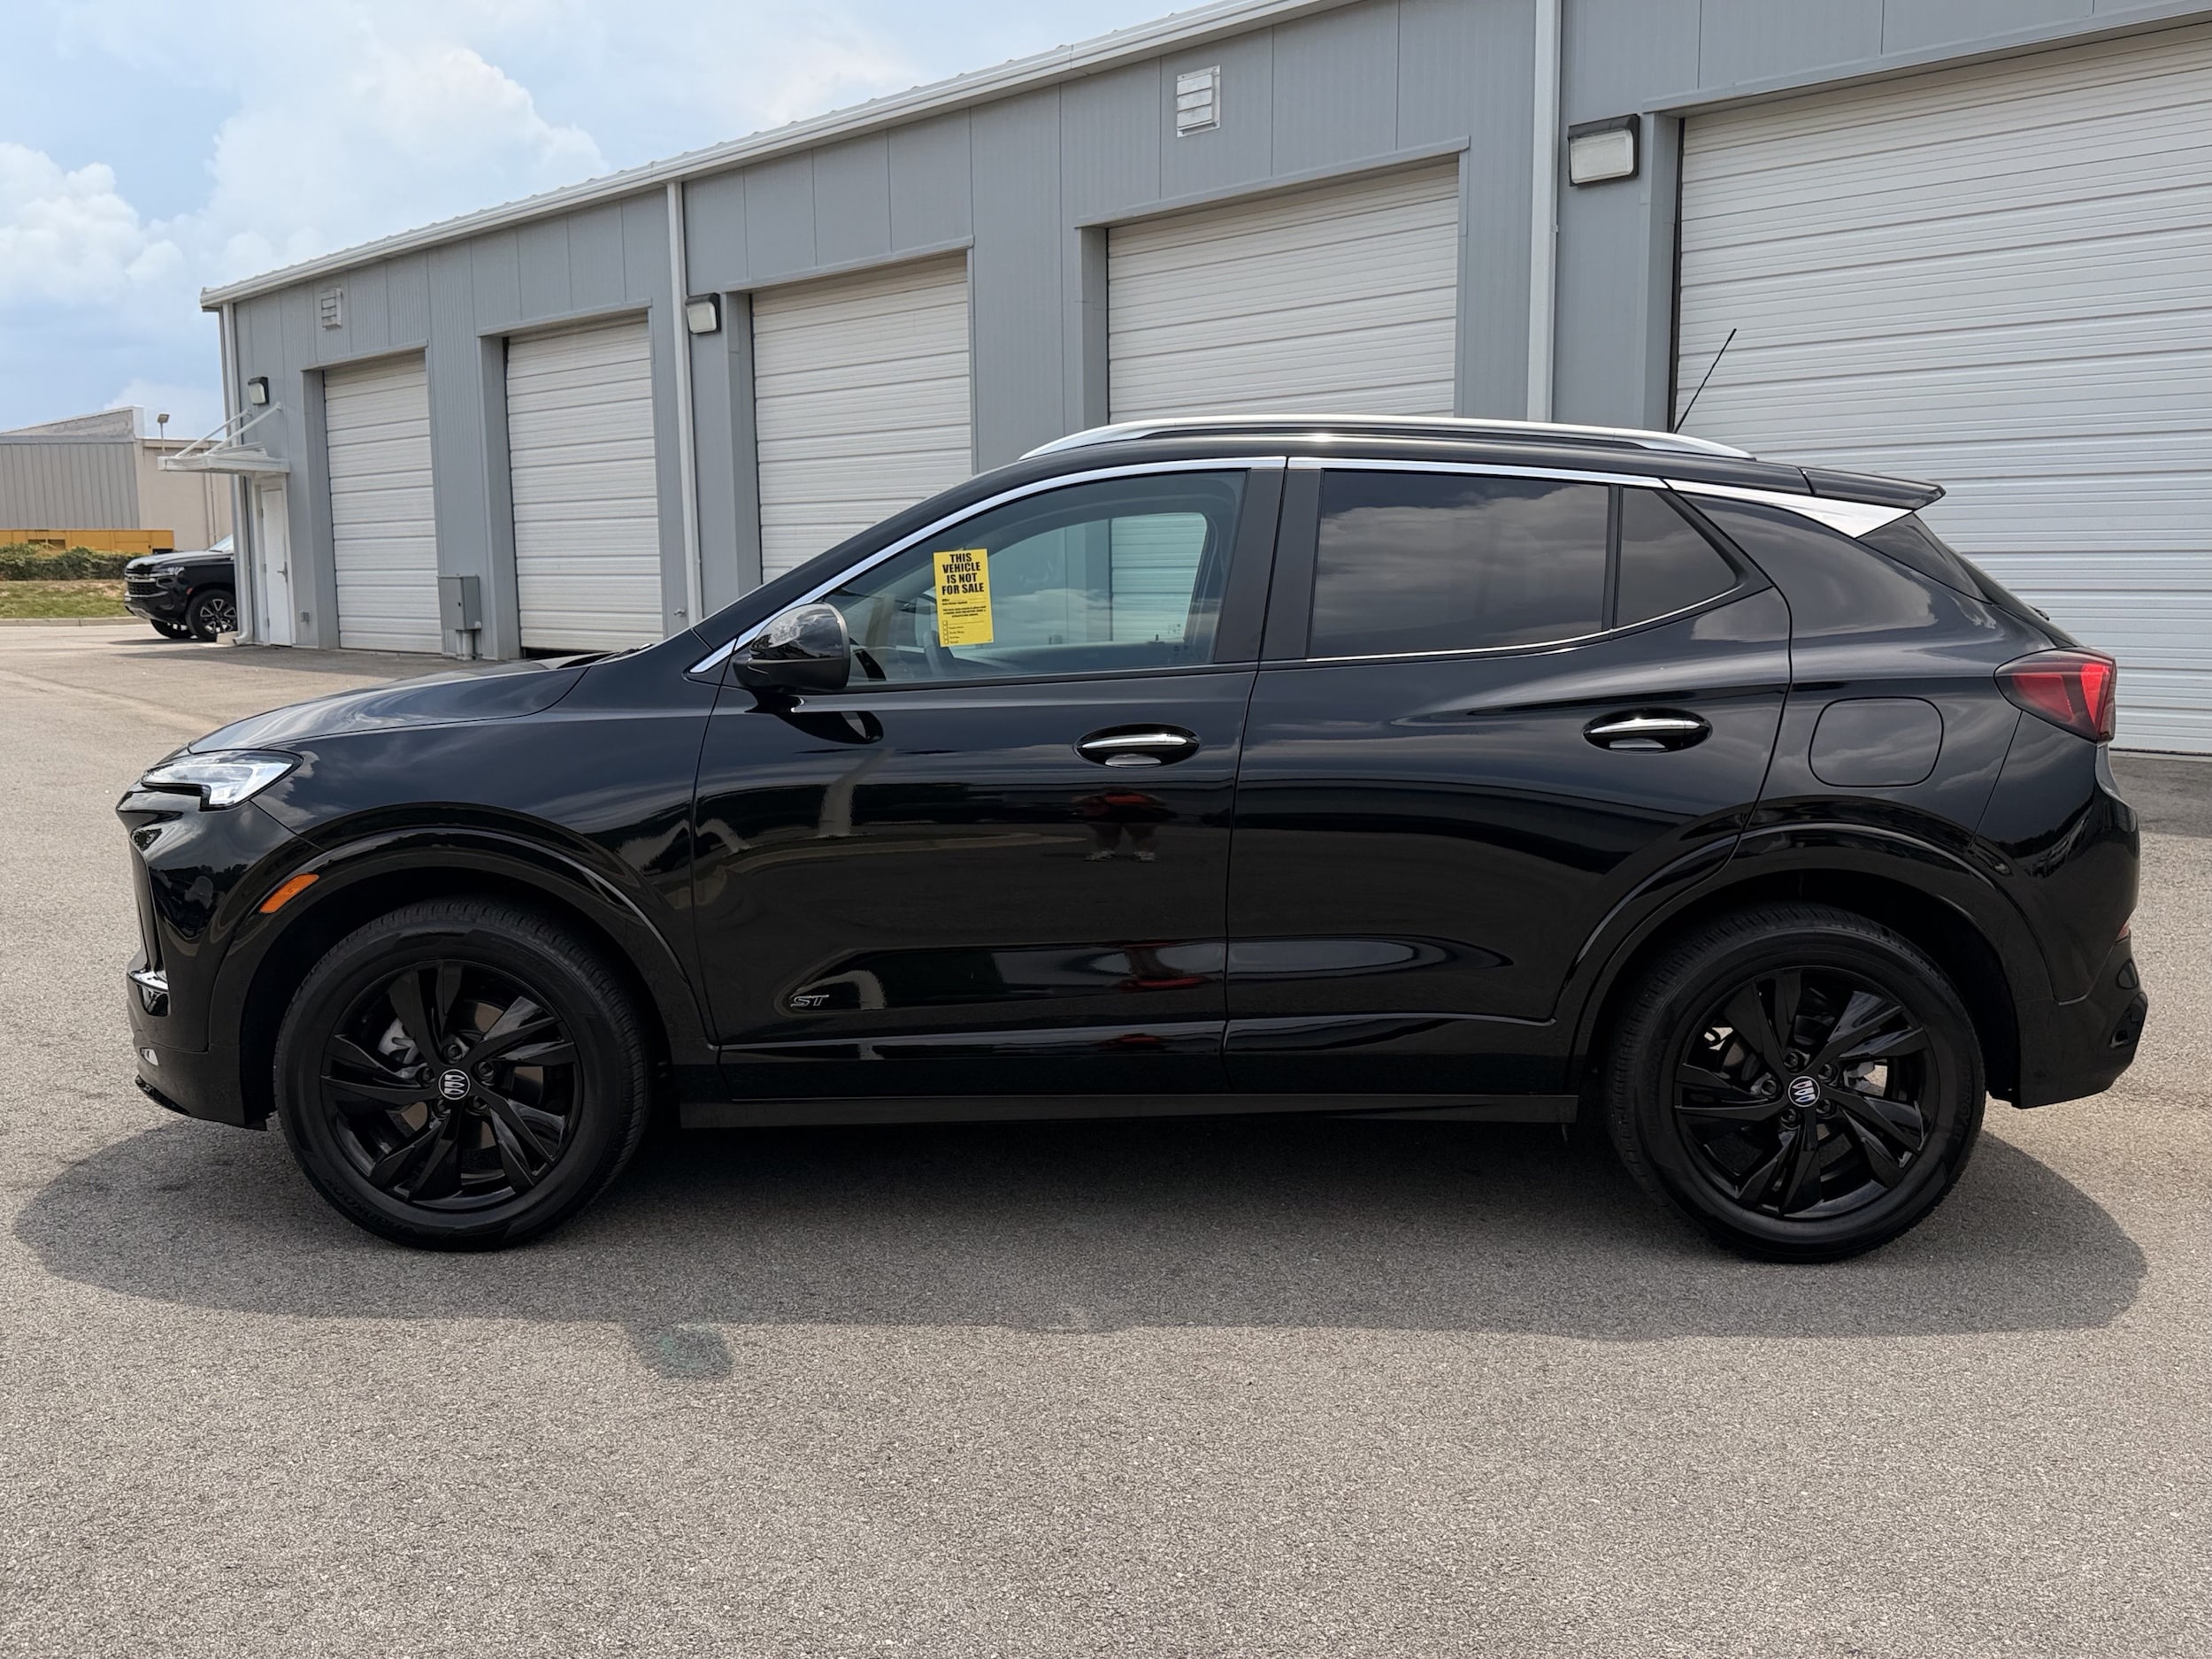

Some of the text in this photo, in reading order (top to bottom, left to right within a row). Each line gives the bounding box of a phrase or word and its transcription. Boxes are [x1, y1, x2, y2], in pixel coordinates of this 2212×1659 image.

[949, 552, 972, 564] THIS
[942, 561, 981, 574] VEHICLE
[947, 572, 977, 584] IS NOT
[941, 582, 985, 595] FOR SALE
[790, 994, 830, 1008] ST
